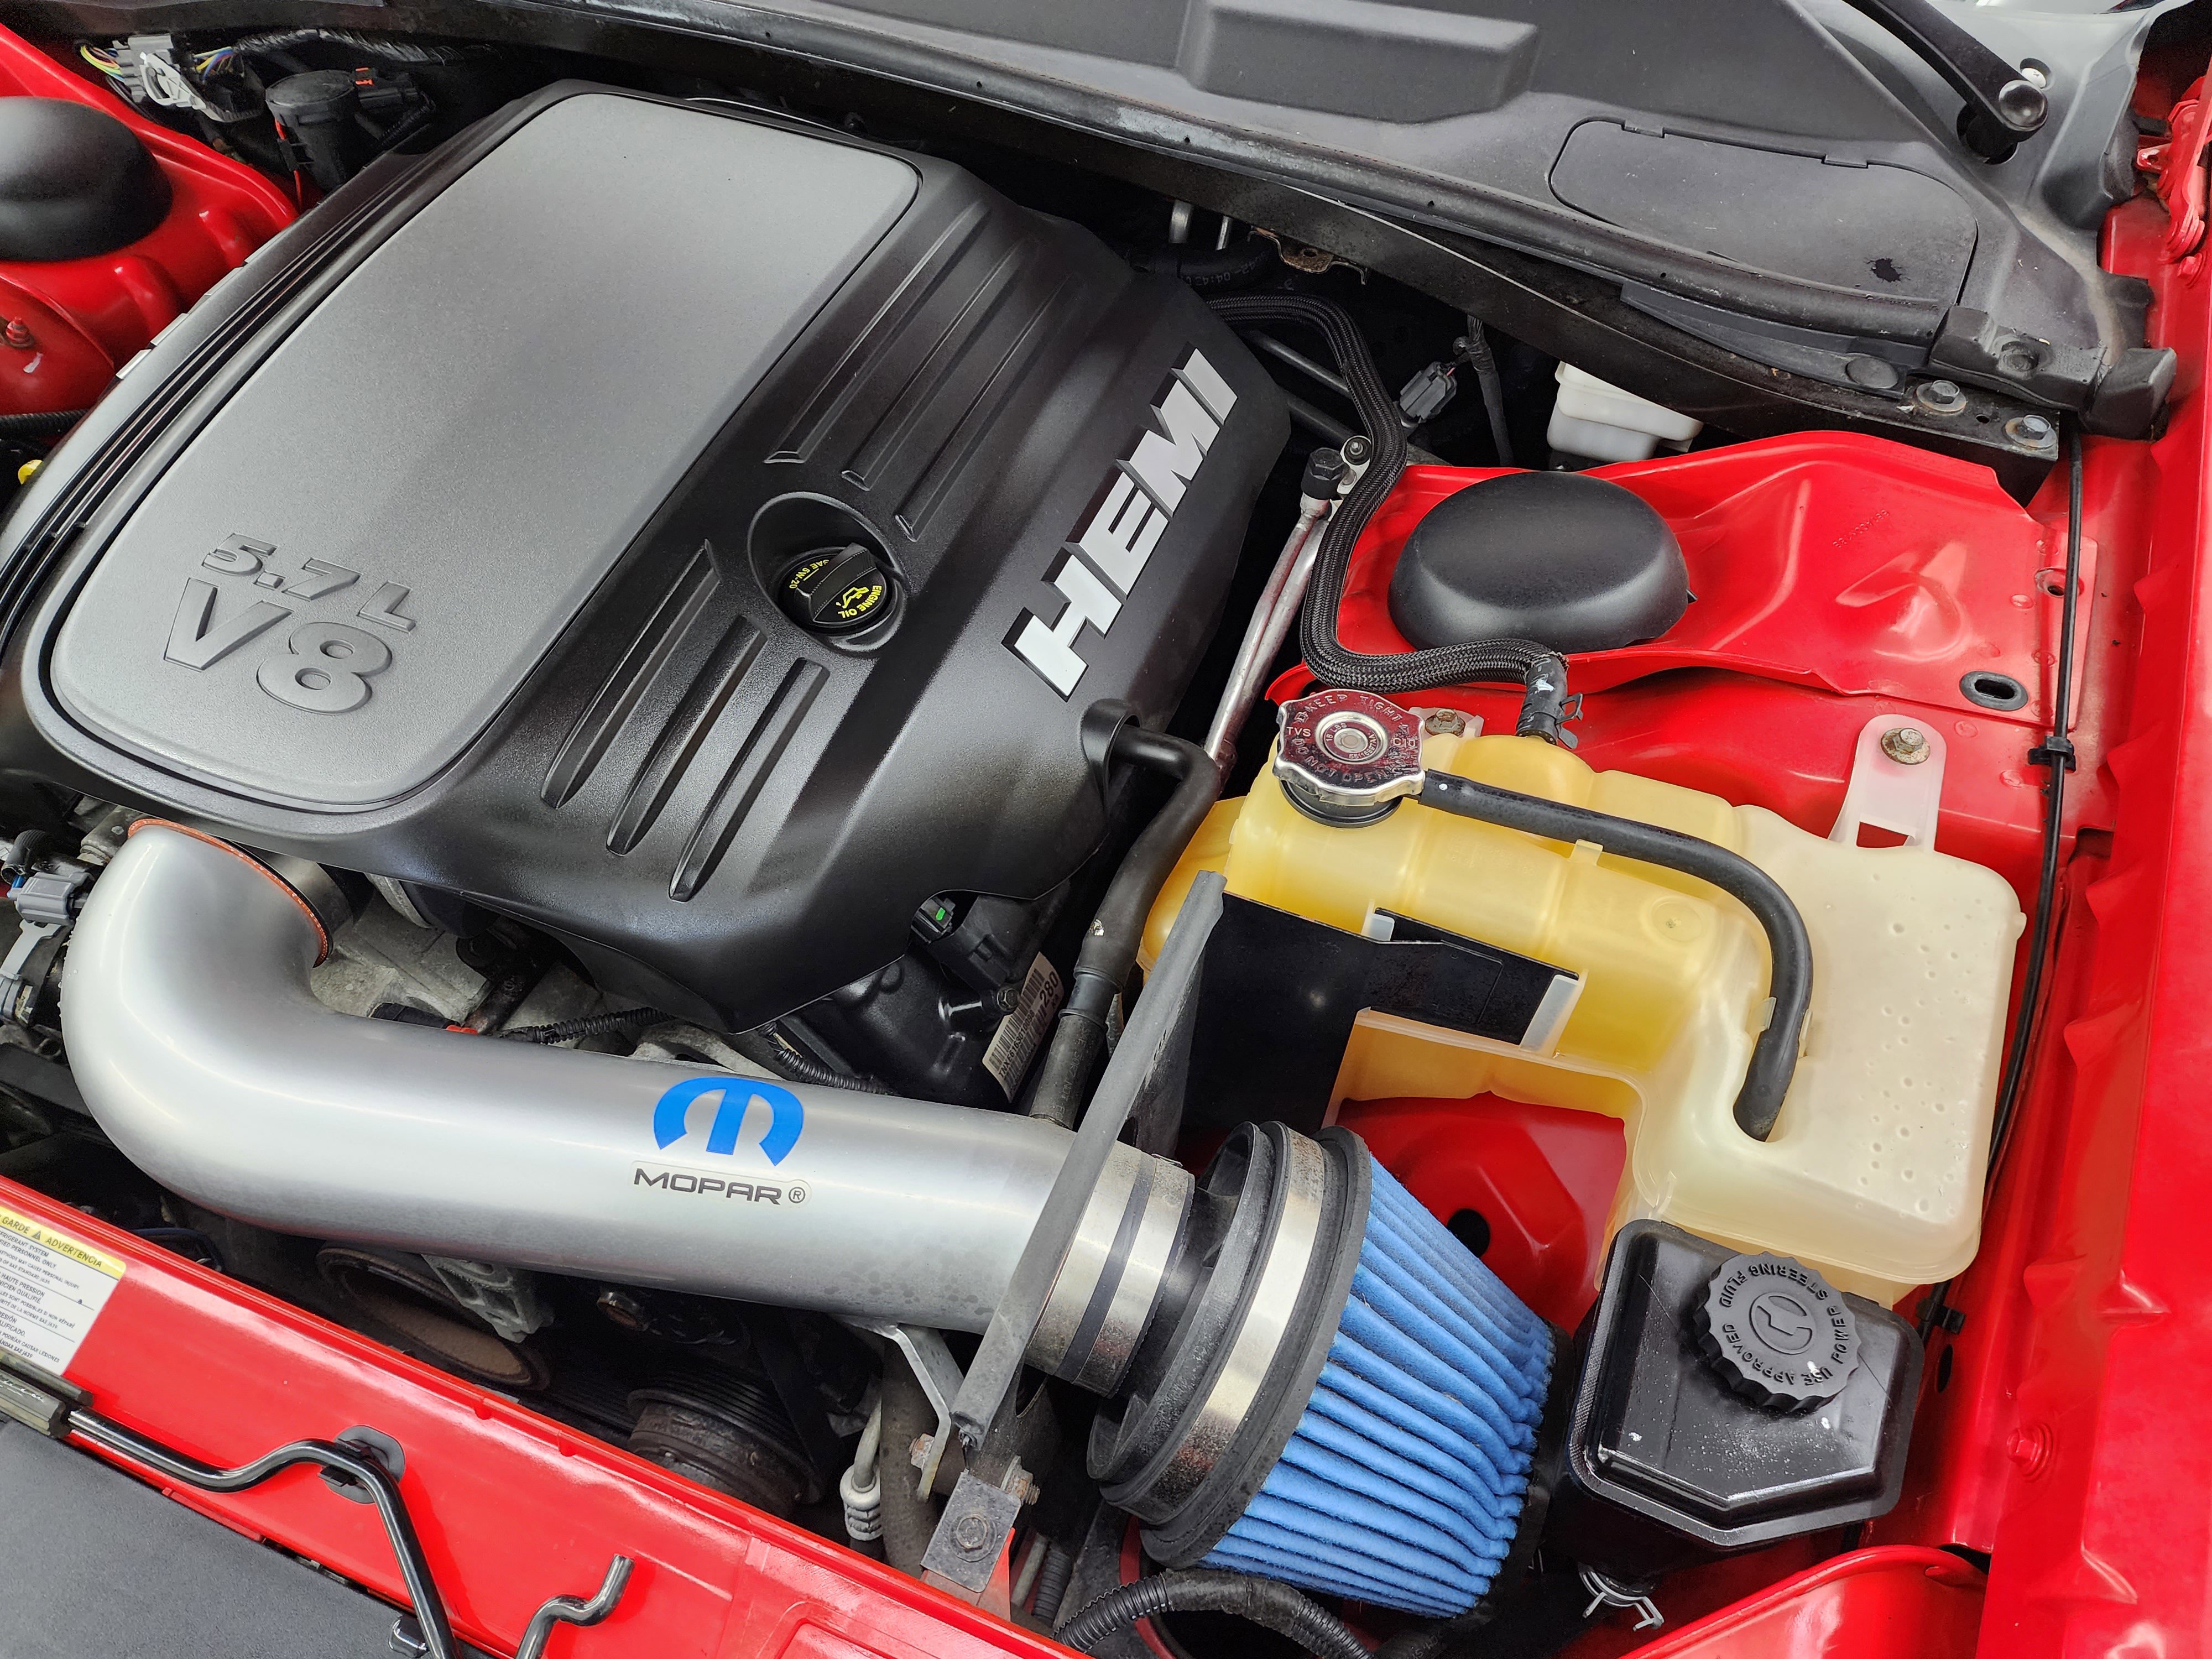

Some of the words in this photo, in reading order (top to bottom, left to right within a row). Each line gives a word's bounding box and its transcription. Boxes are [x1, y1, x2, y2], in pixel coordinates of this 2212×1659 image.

[1008, 347, 1238, 700] HEMI
[810, 559, 830, 570] SAE
[789, 567, 811, 589] 5W-20
[859, 585, 882, 612] ENGINE
[838, 609, 858, 618] OIL
[163, 577, 393, 715] V8
[1304, 693, 1348, 714] KEEP
[1359, 695, 1404, 723] TIGHT
[1286, 726, 1312, 737] TVS
[1326, 733, 1334, 742] 18
[1331, 723, 1348, 733] LBS
[1305, 755, 1337, 778] NOT
[1039, 971, 1060, 1007] 280
[634, 1168, 781, 1205] MOPAR
[2, 1216, 30, 1234] GARDE
[45, 1237, 102, 1268] ADVERTENCIA
[12, 1245, 41, 1263] PERSONNEL
[28, 1244, 50, 1258] SYSTEM
[18, 1257, 28, 1265] MAY
[28, 1262, 42, 1273] CAUSE
[42, 1270, 64, 1283] PERSONAL
[18, 1266, 40, 1280] STANDARD
[1748, 1262, 1829, 1301] STEERING
[1, 1273, 19, 1286] HAUTE
[19, 1281, 45, 1298] PRESSION
[1719, 1270, 1748, 1308] FLUID
[8, 1294, 20, 1303] SONT
[20, 1300, 44, 1314] POSSIBLES
[23, 1309, 39, 1320] NORME
[2, 1332, 22, 1344] PODRÍAN
[21, 1341, 39, 1353] CAUSAR
[38, 1349, 60, 1363] LESIONES
[1827, 1305, 1850, 1365] POWER
[1721, 1323, 1797, 1386] APPROVED
[1801, 1366, 1833, 1386] USE
